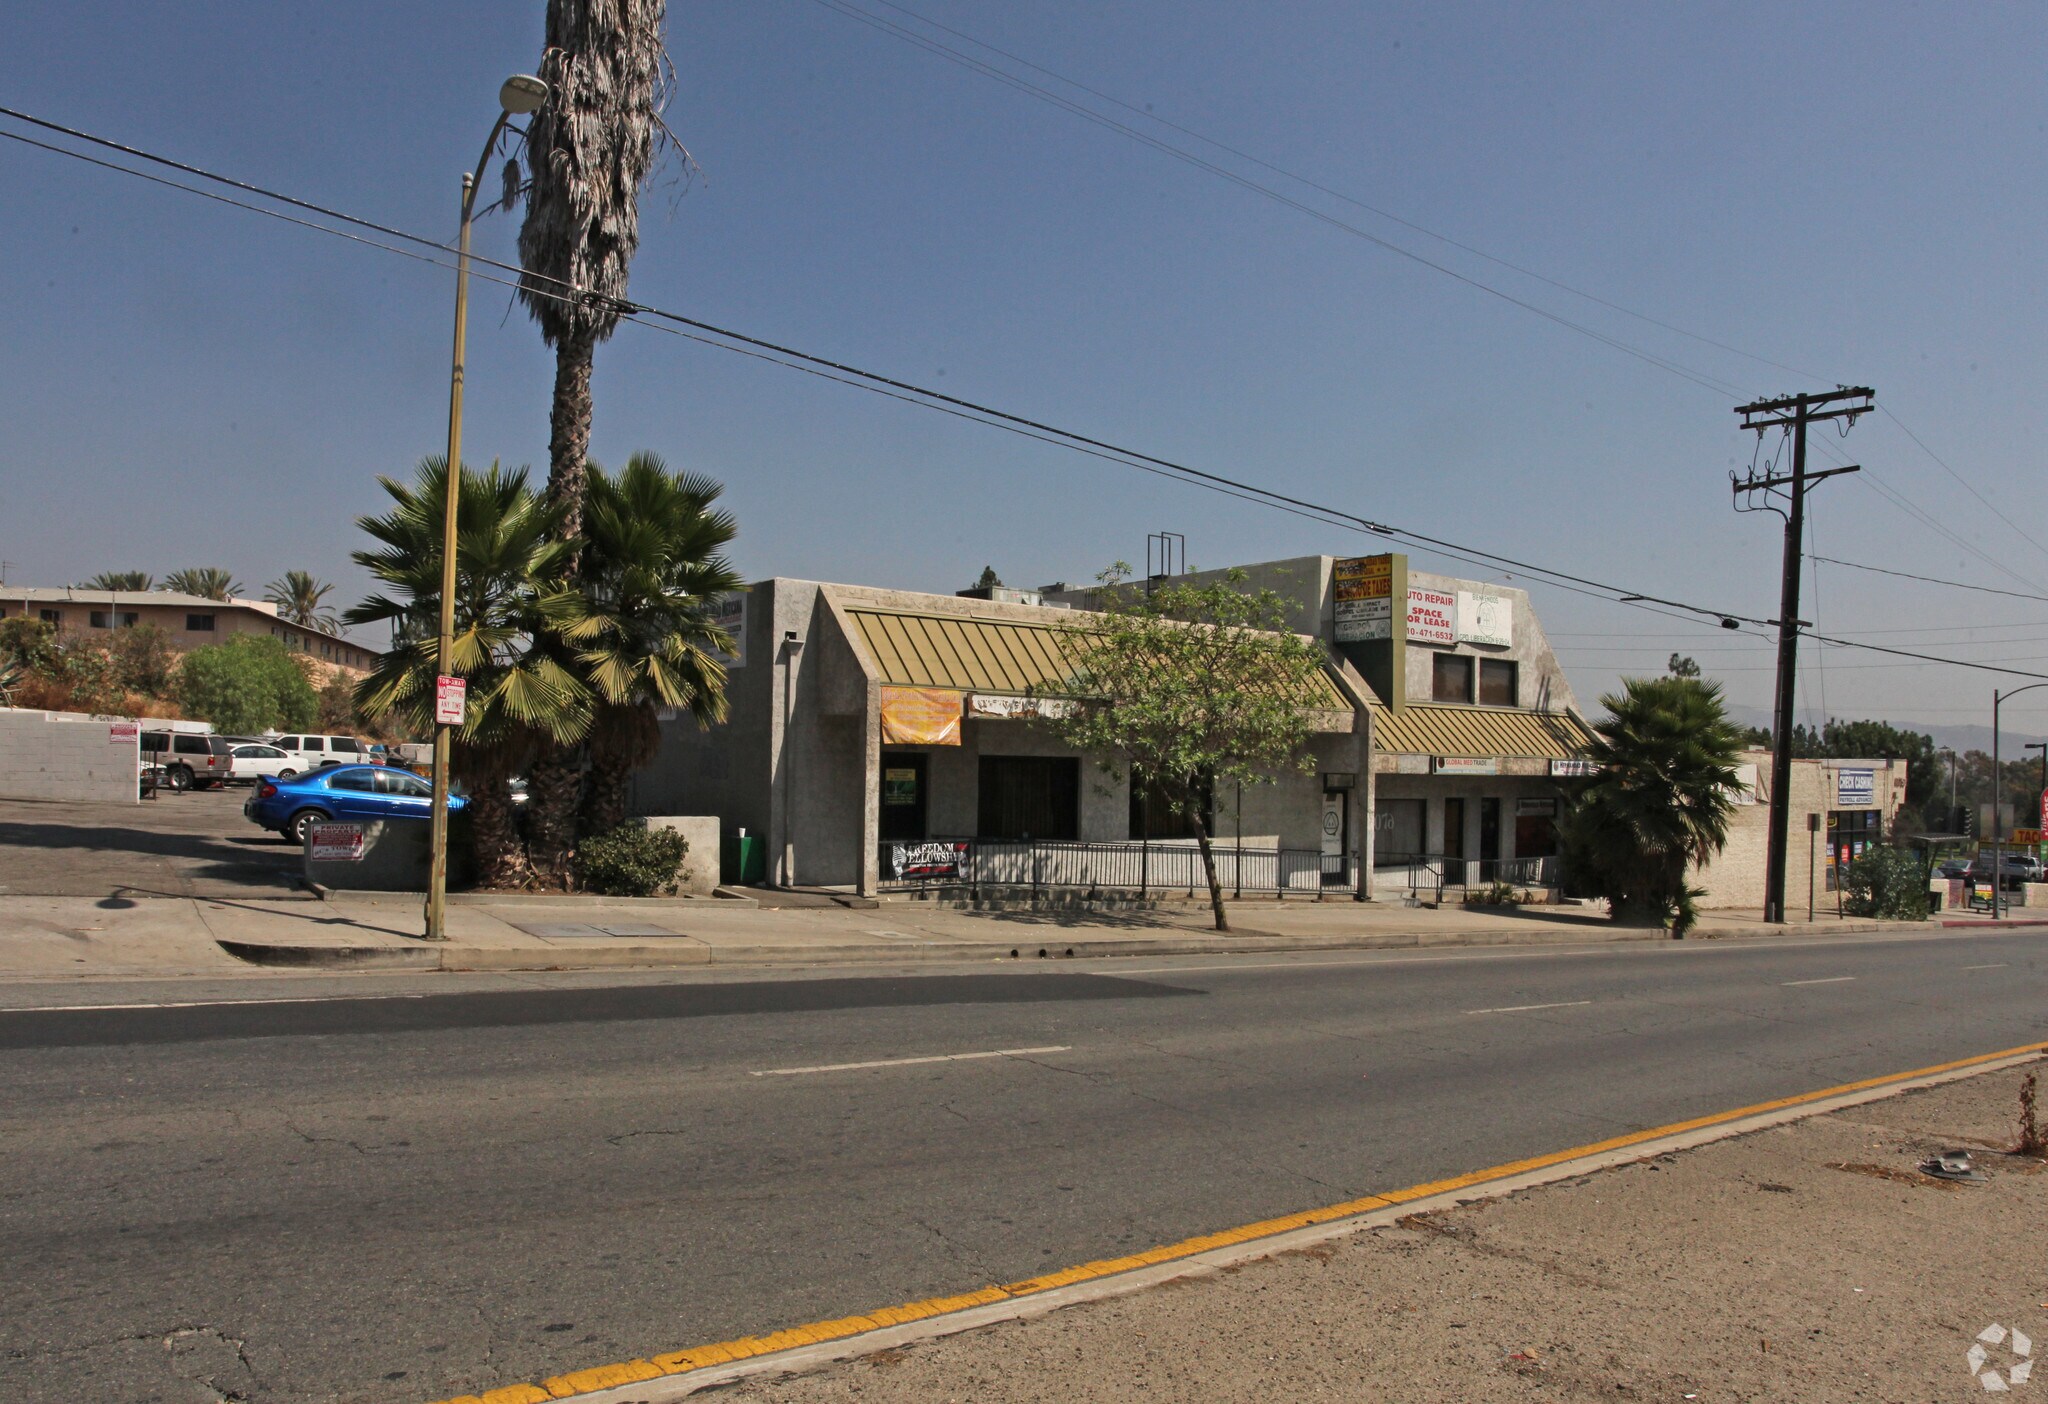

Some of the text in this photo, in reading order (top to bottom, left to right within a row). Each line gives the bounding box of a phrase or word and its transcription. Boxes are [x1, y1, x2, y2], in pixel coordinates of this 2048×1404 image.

[1372, 577, 1391, 595] TAXES
[1407, 591, 1454, 606] UTO REPAIR
[1412, 606, 1443, 618] SPACE
[1407, 614, 1450, 628] OR LEASE
[1407, 627, 1454, 640] 10-471-6532
[439, 677, 464, 687] TOW-AWAY
[439, 685, 464, 699] NO STOPPING
[441, 701, 462, 710] ANY TIME
[1839, 775, 1873, 790] CHECK CASHING
[2018, 830, 2040, 844] TAC
